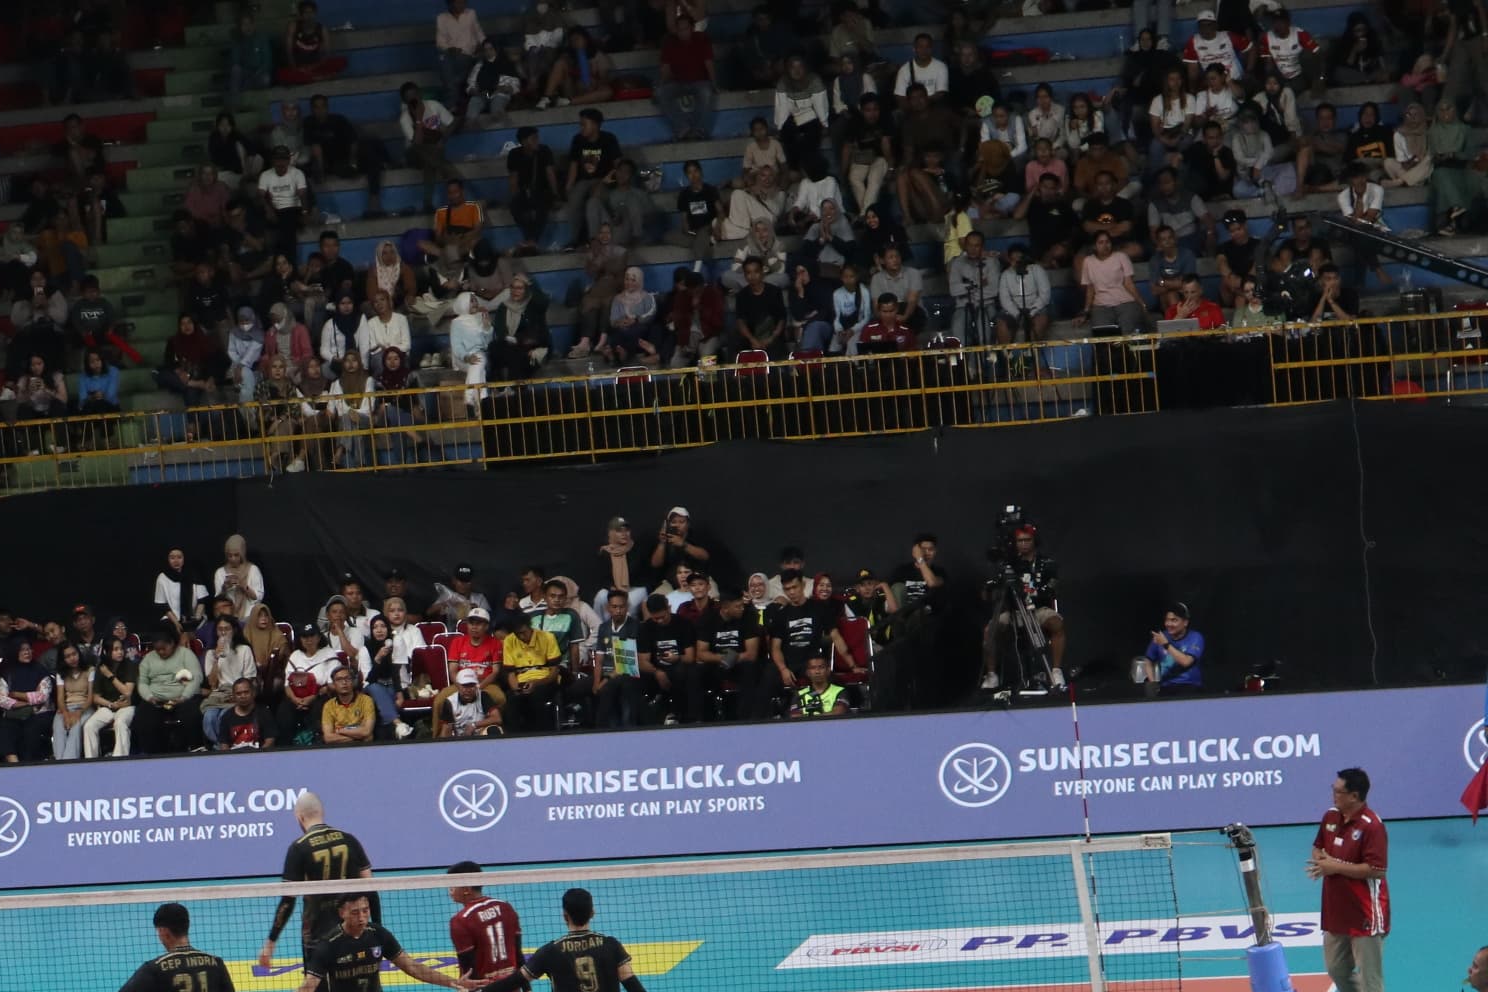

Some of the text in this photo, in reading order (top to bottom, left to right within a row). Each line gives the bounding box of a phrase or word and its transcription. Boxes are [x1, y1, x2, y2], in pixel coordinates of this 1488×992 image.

[1018, 732, 1321, 772] SUNRISECLICK.COM
[515, 760, 801, 798] SUNRISECLICK.COM
[1053, 770, 1283, 796] EVERYONE CAN PLAY SPORTS
[36, 787, 307, 824] SUNRISECLICK.COM
[548, 795, 765, 821] EVERYONE CAN PLAY SPORTS
[67, 822, 274, 847] EVERYONE CAN PLAY SPORTS
[313, 844, 349, 880] 77
[478, 905, 501, 922] RUBY
[486, 921, 507, 963] 11
[561, 937, 603, 953] JORDAN
[161, 958, 181, 971] CEP
